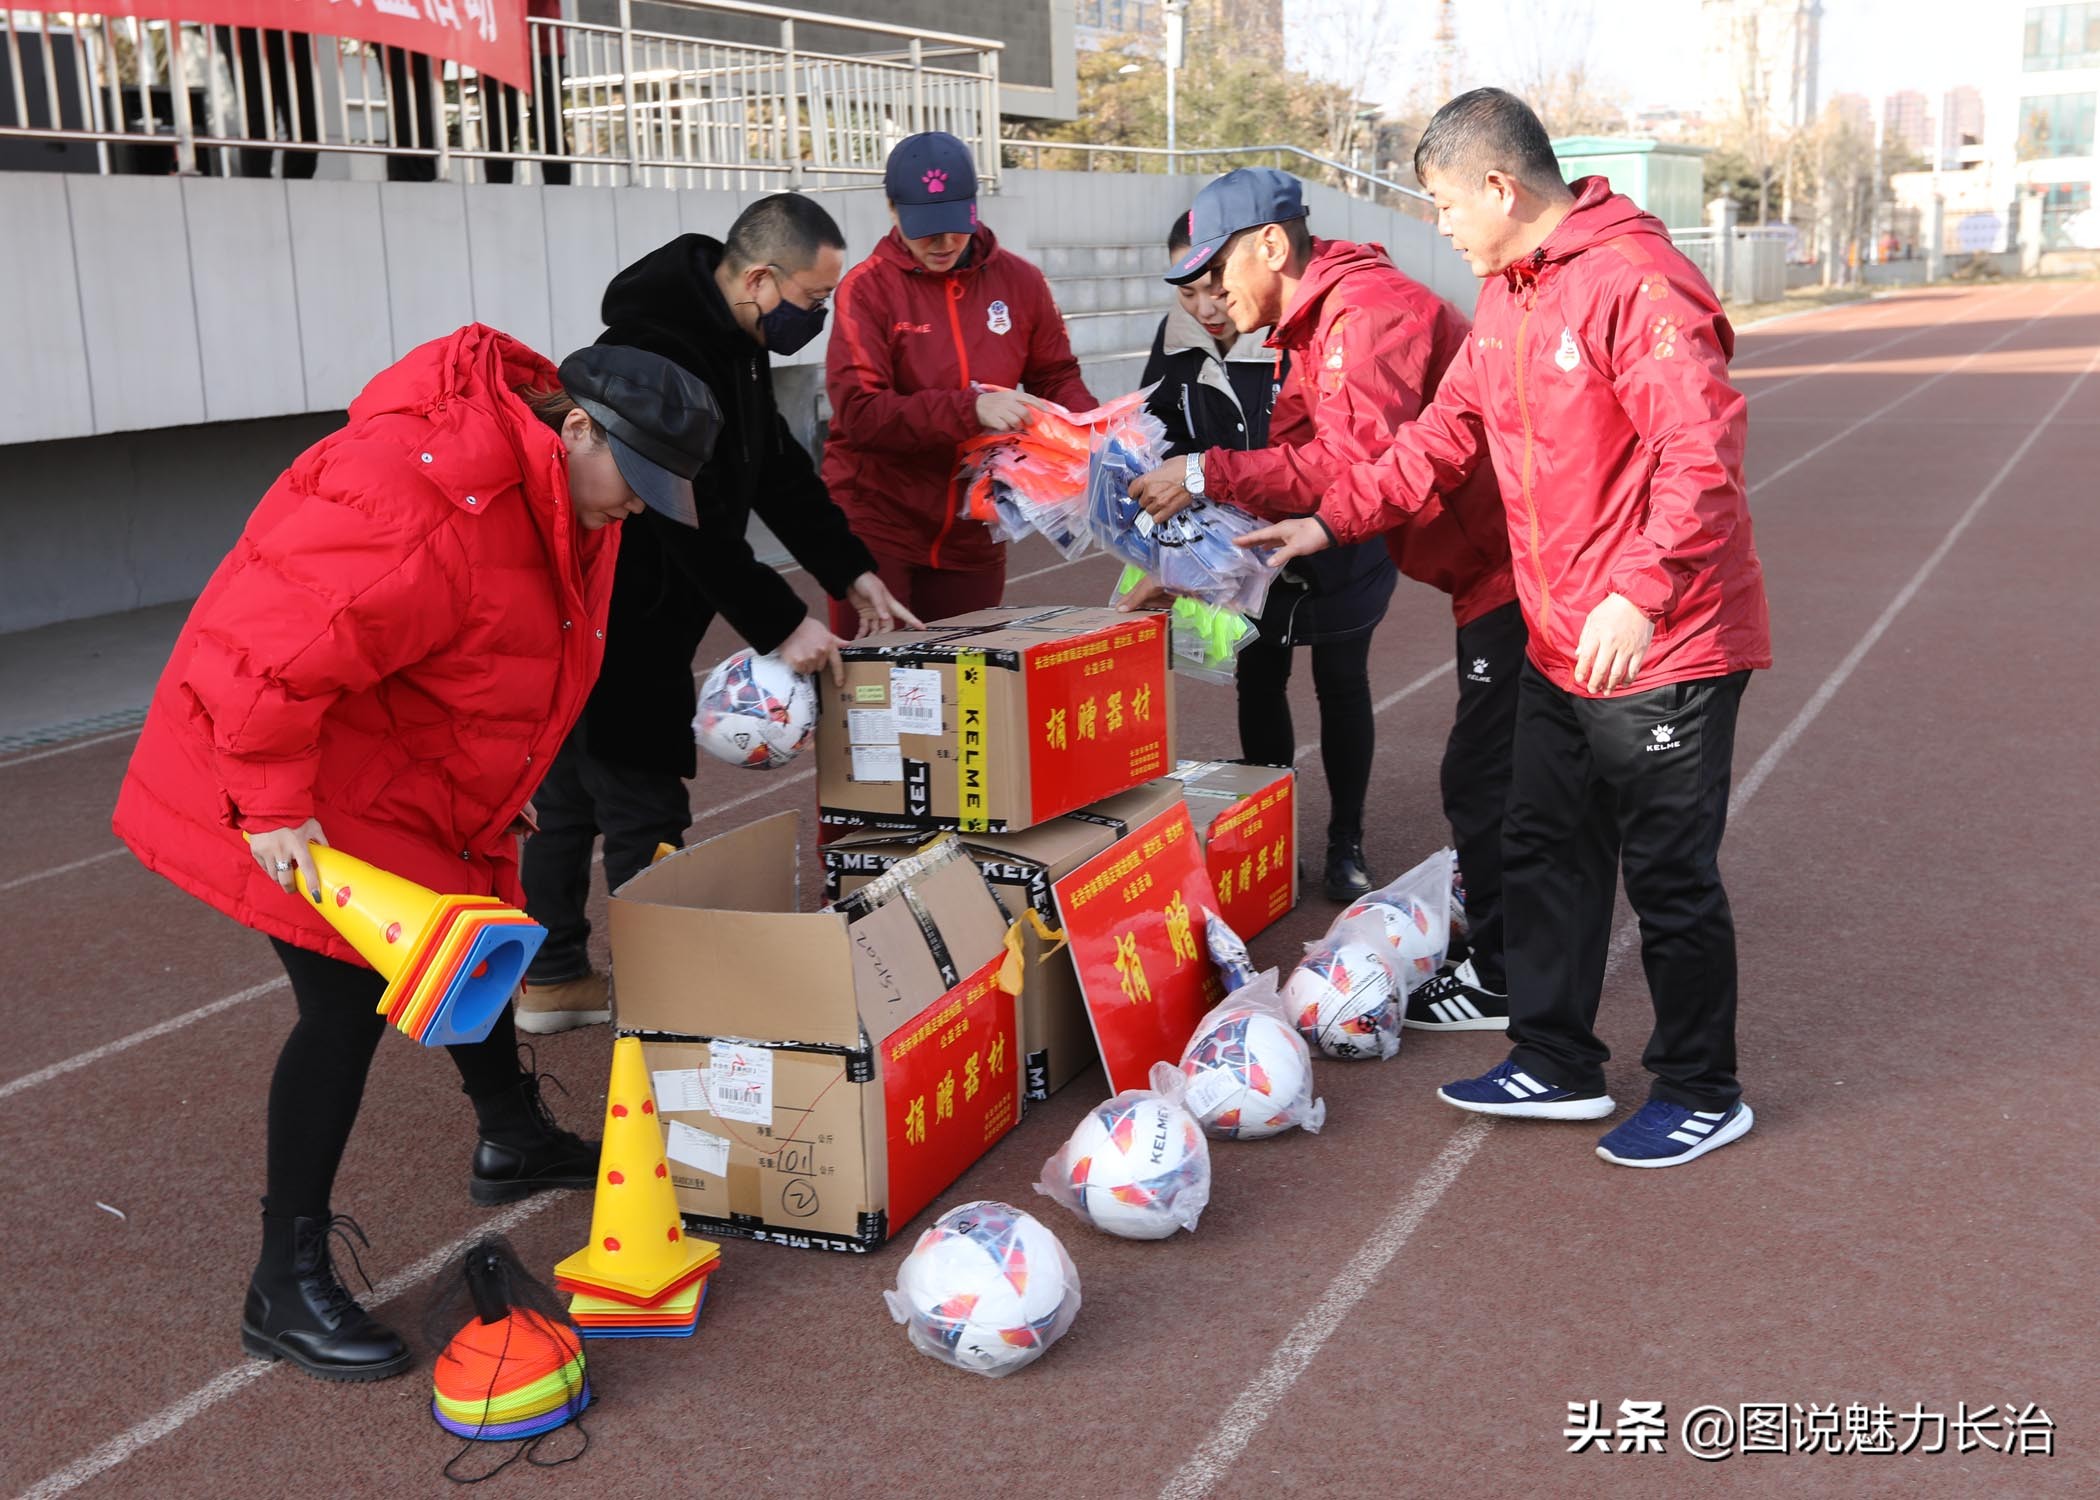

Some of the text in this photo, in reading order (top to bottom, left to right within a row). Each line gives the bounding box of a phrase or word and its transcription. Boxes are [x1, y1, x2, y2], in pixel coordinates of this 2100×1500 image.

[1045, 682, 1151, 751] 捐赠器材
[1646, 740, 1681, 752] KELME
[965, 709, 980, 809] KELME
[1218, 835, 1285, 905] 捐赠器材
[905, 1031, 1005, 1147] 捐赠器材
[1150, 1104, 1170, 1164] KELME
